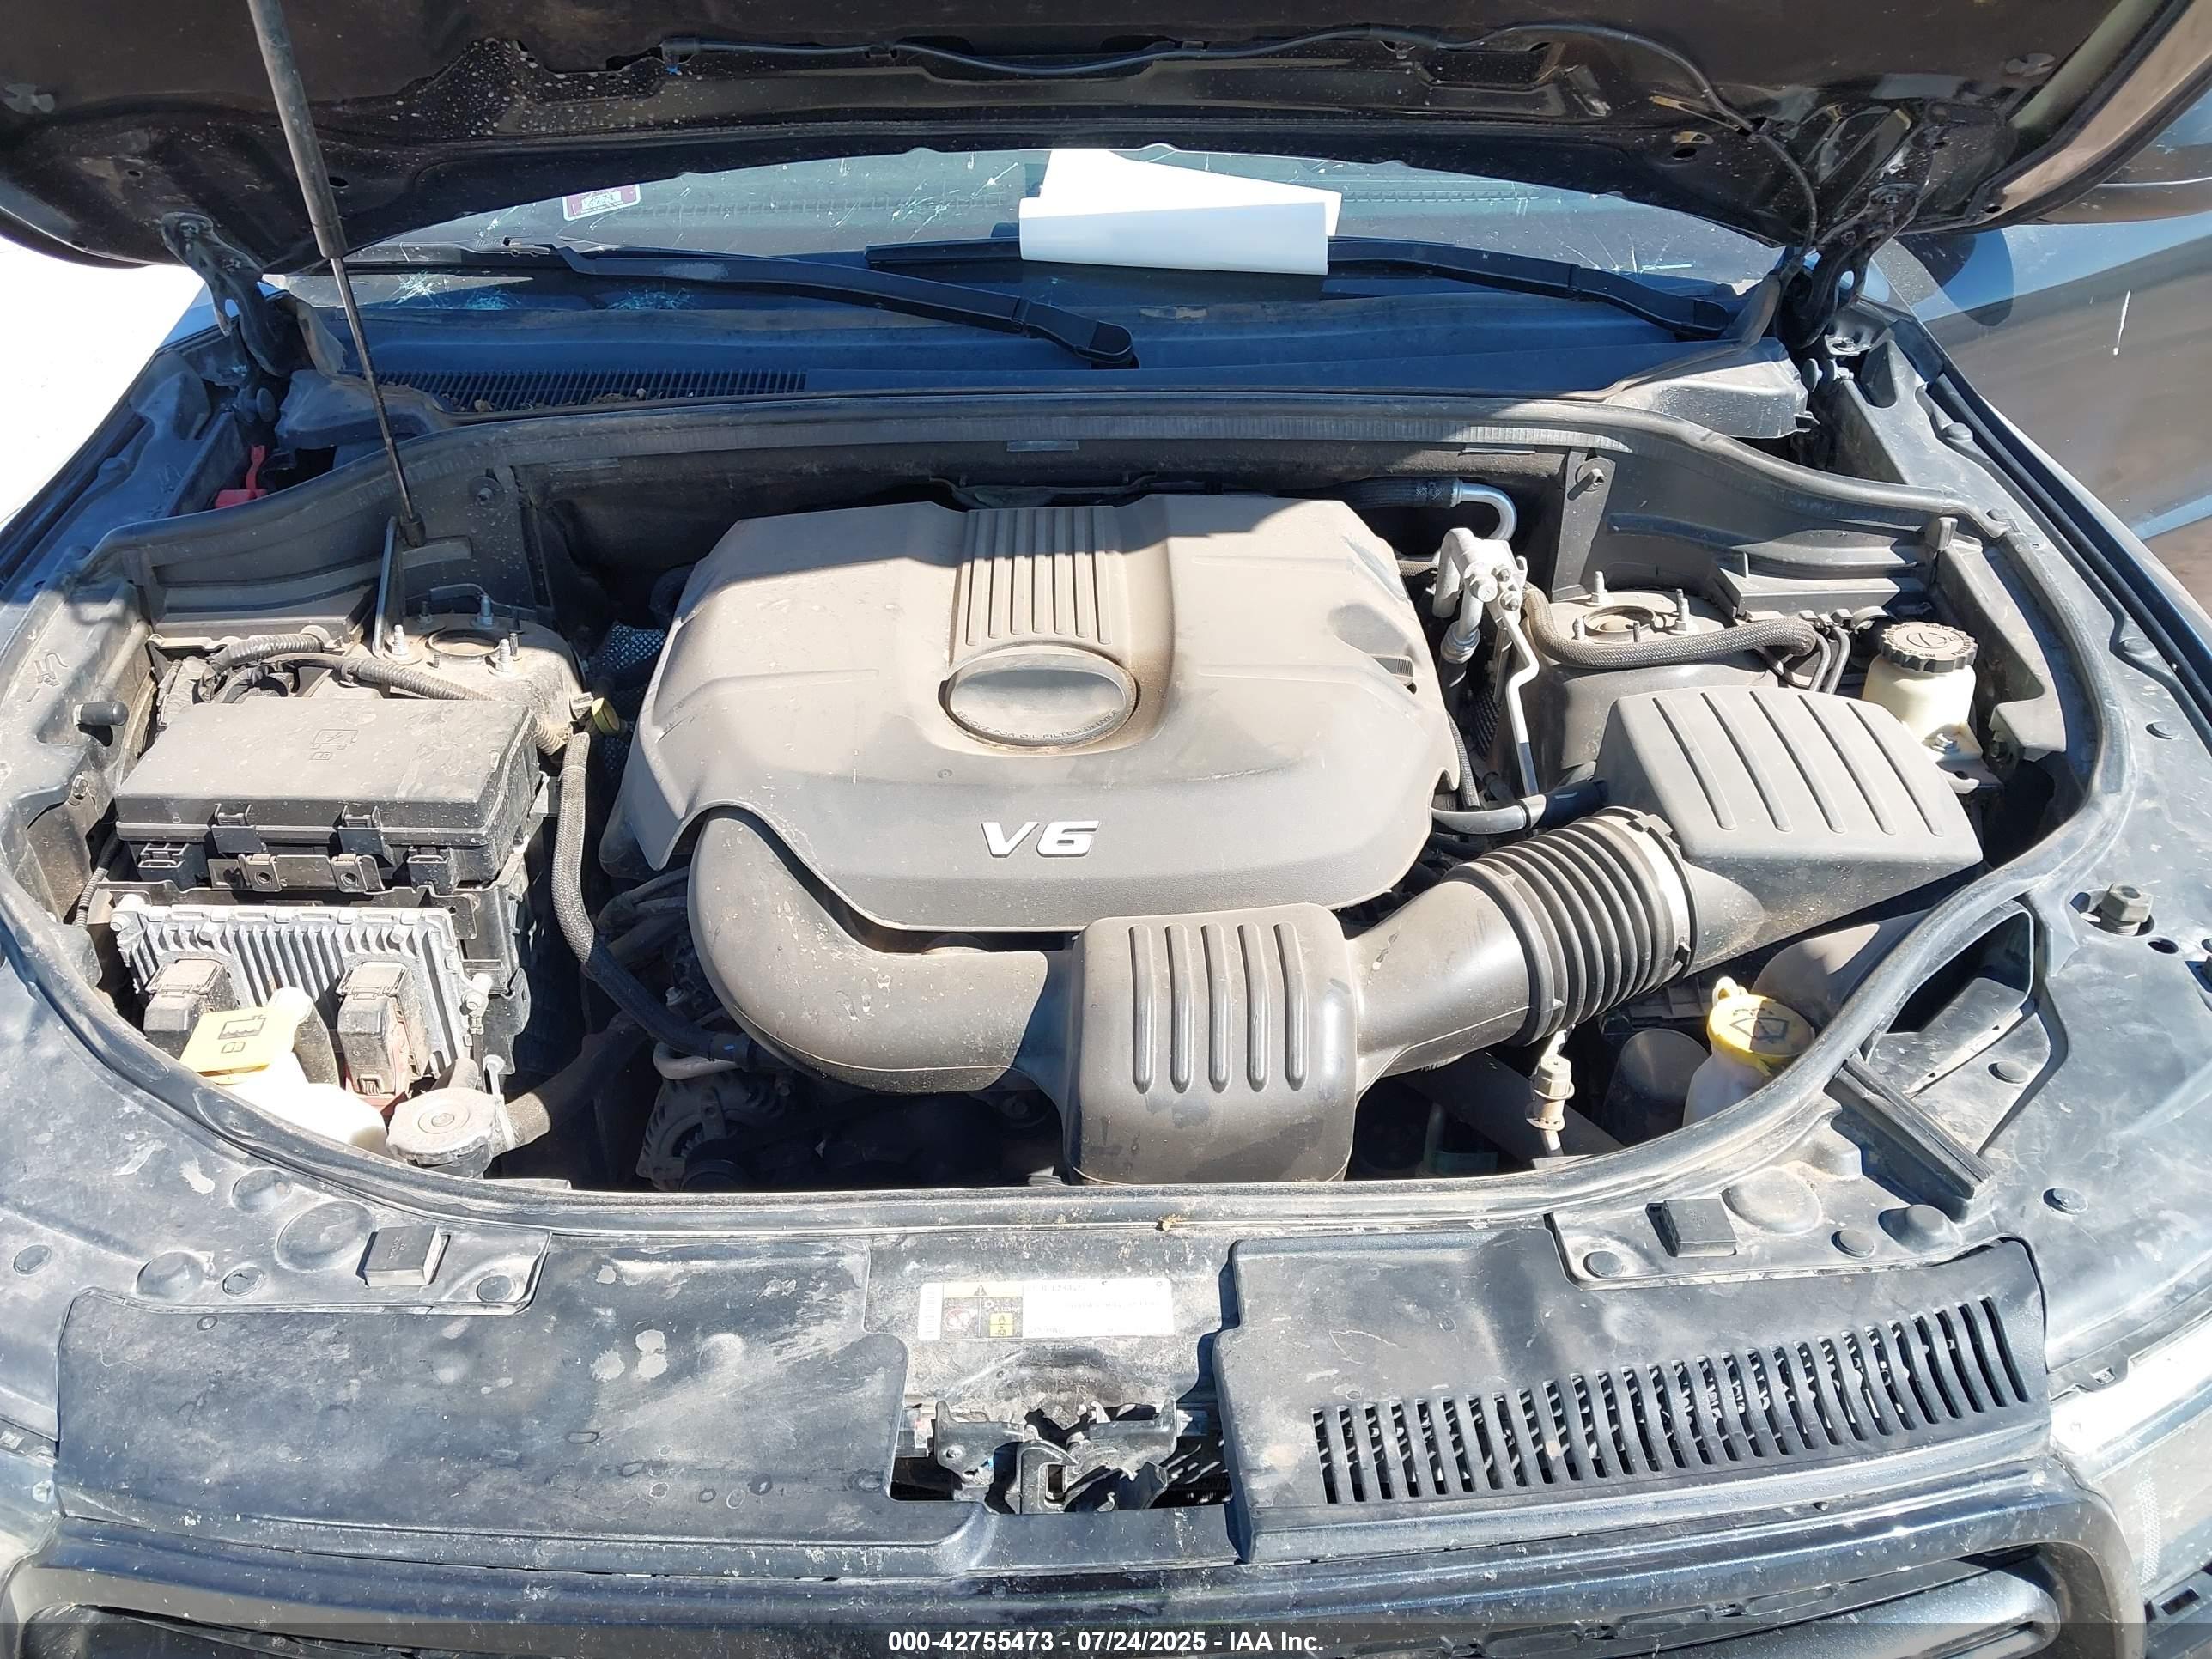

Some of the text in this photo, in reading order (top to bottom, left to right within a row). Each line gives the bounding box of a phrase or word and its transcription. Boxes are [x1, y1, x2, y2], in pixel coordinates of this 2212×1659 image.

[955, 709, 990, 731] REMOVE
[992, 729, 1016, 738] FOR
[981, 820, 1100, 858] V6
